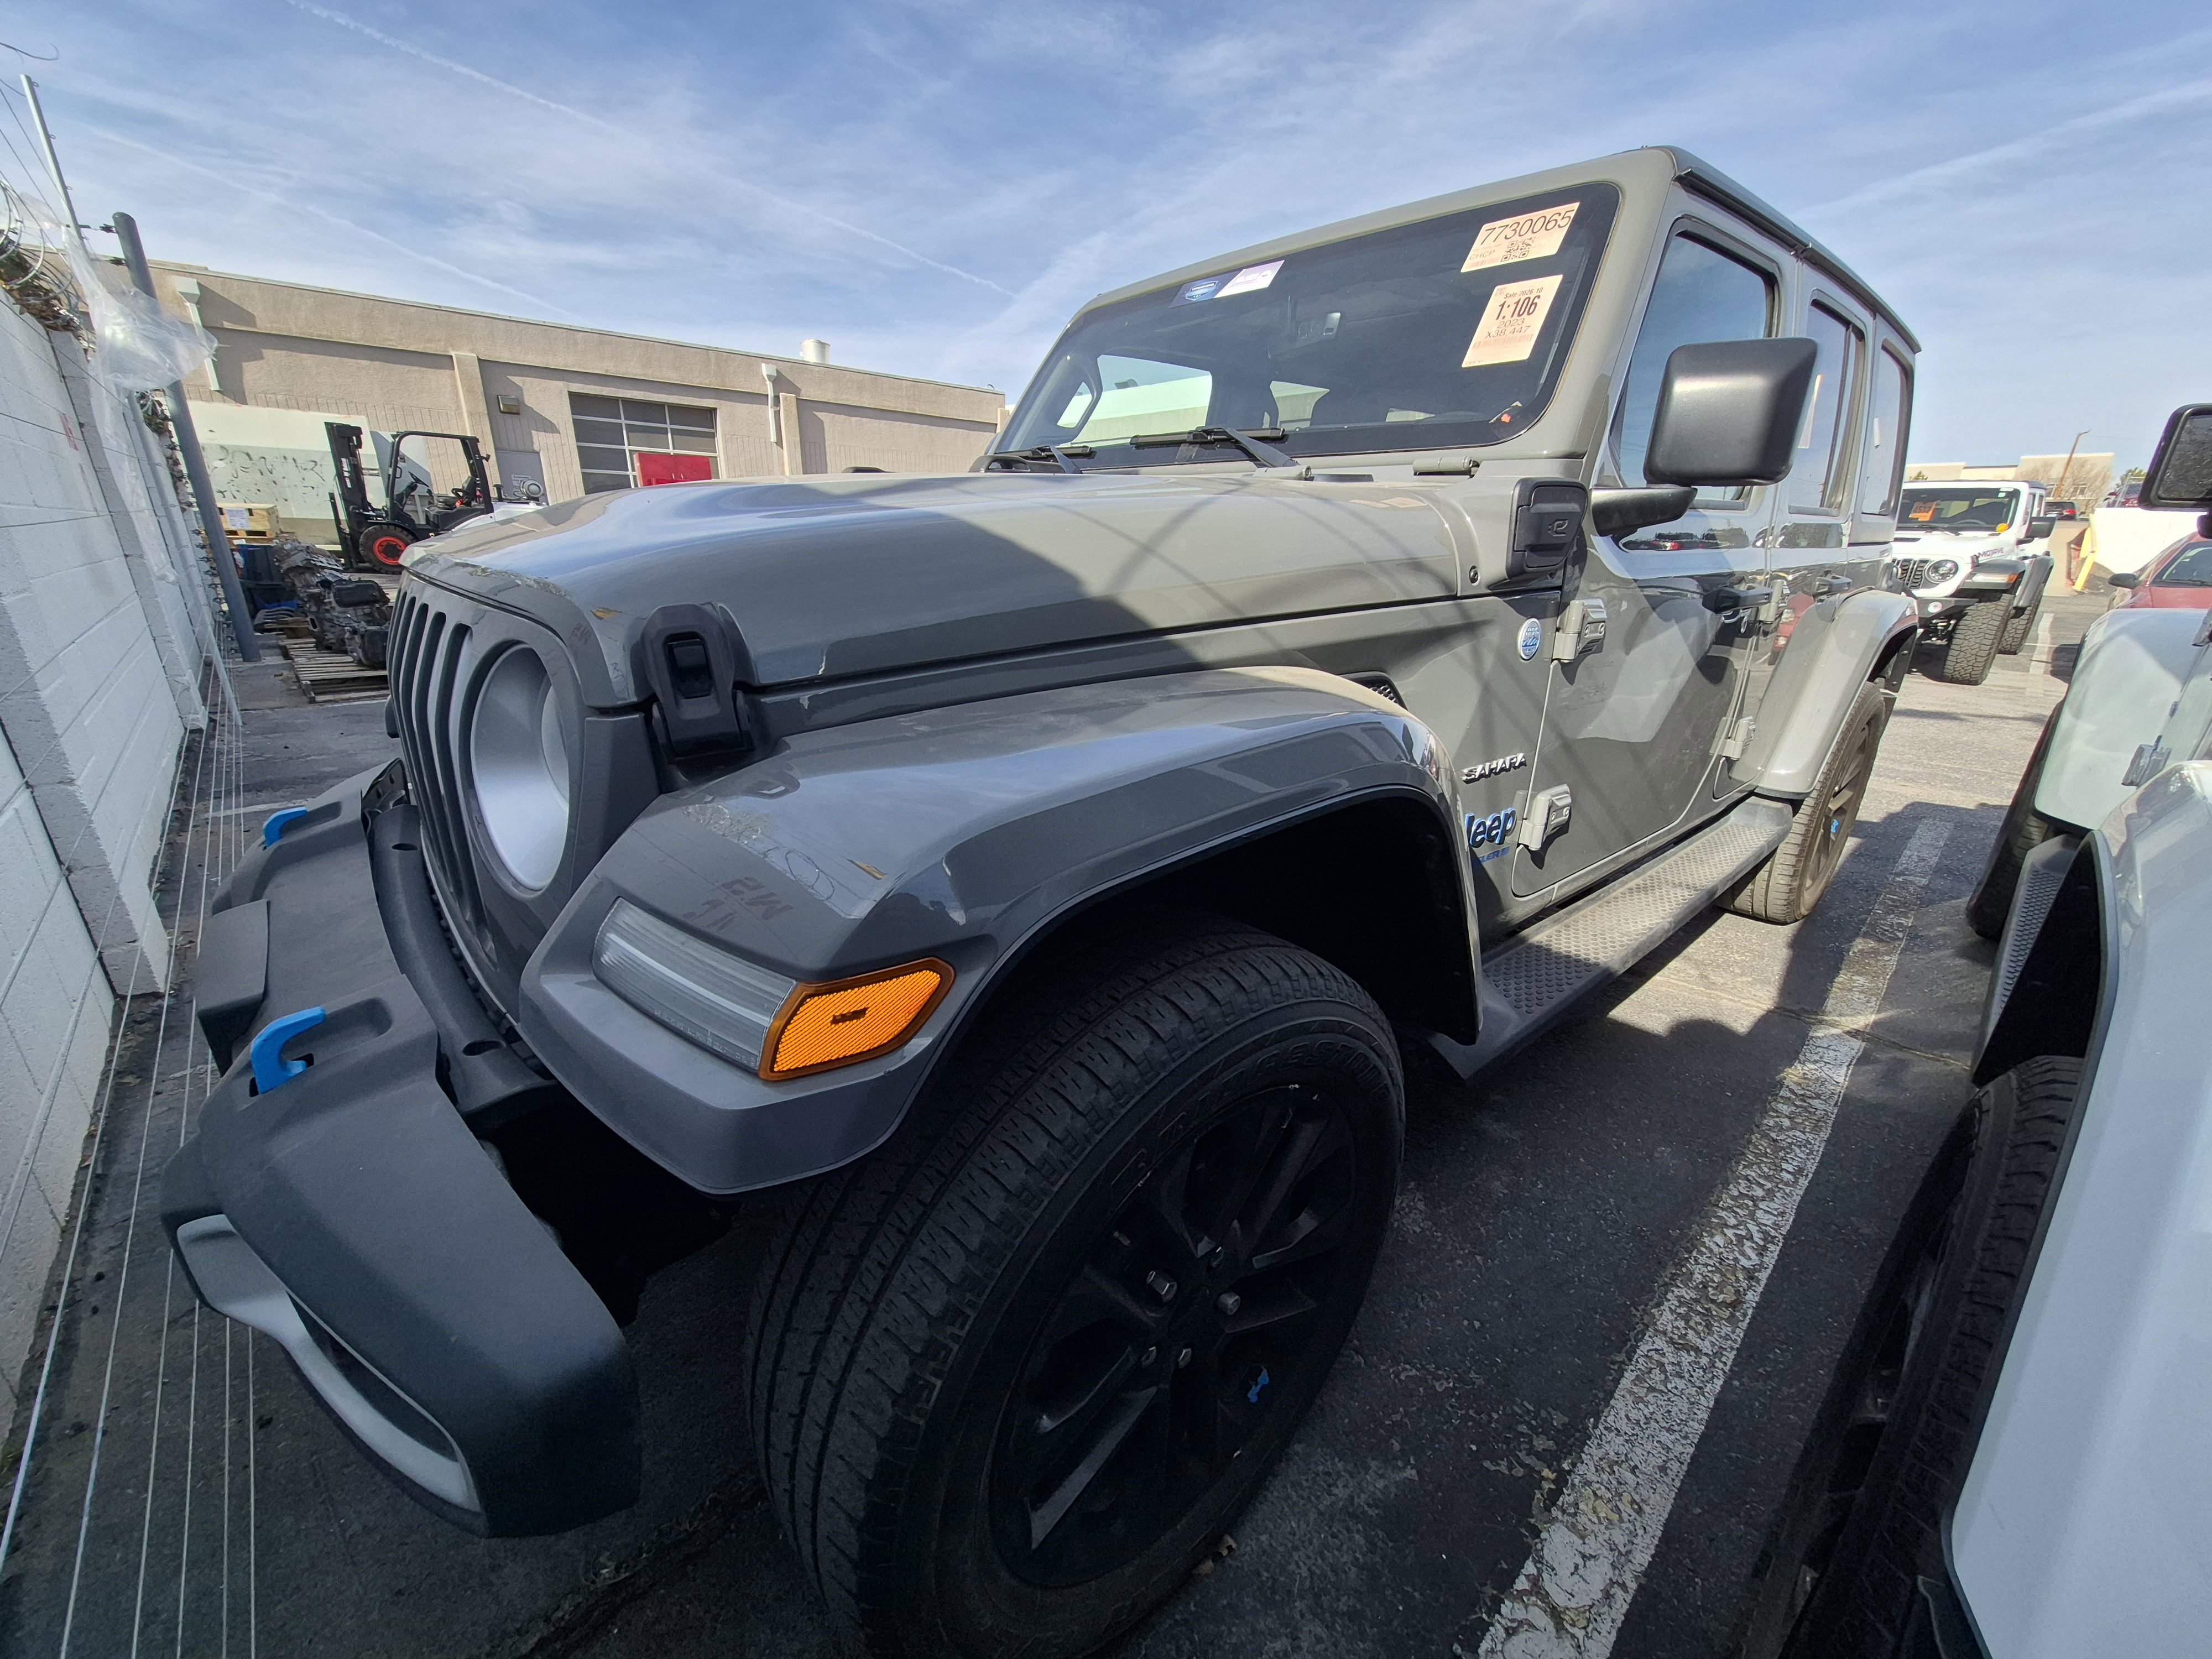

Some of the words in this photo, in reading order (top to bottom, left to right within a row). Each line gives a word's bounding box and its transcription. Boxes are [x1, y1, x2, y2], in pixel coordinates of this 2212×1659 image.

[1480, 209, 1575, 246] 7730065
[1469, 249, 1495, 260] CHCP
[1495, 295, 1541, 321] 1:106
[1497, 317, 1525, 329] 2023
[1462, 753, 1527, 783] SAHARA
